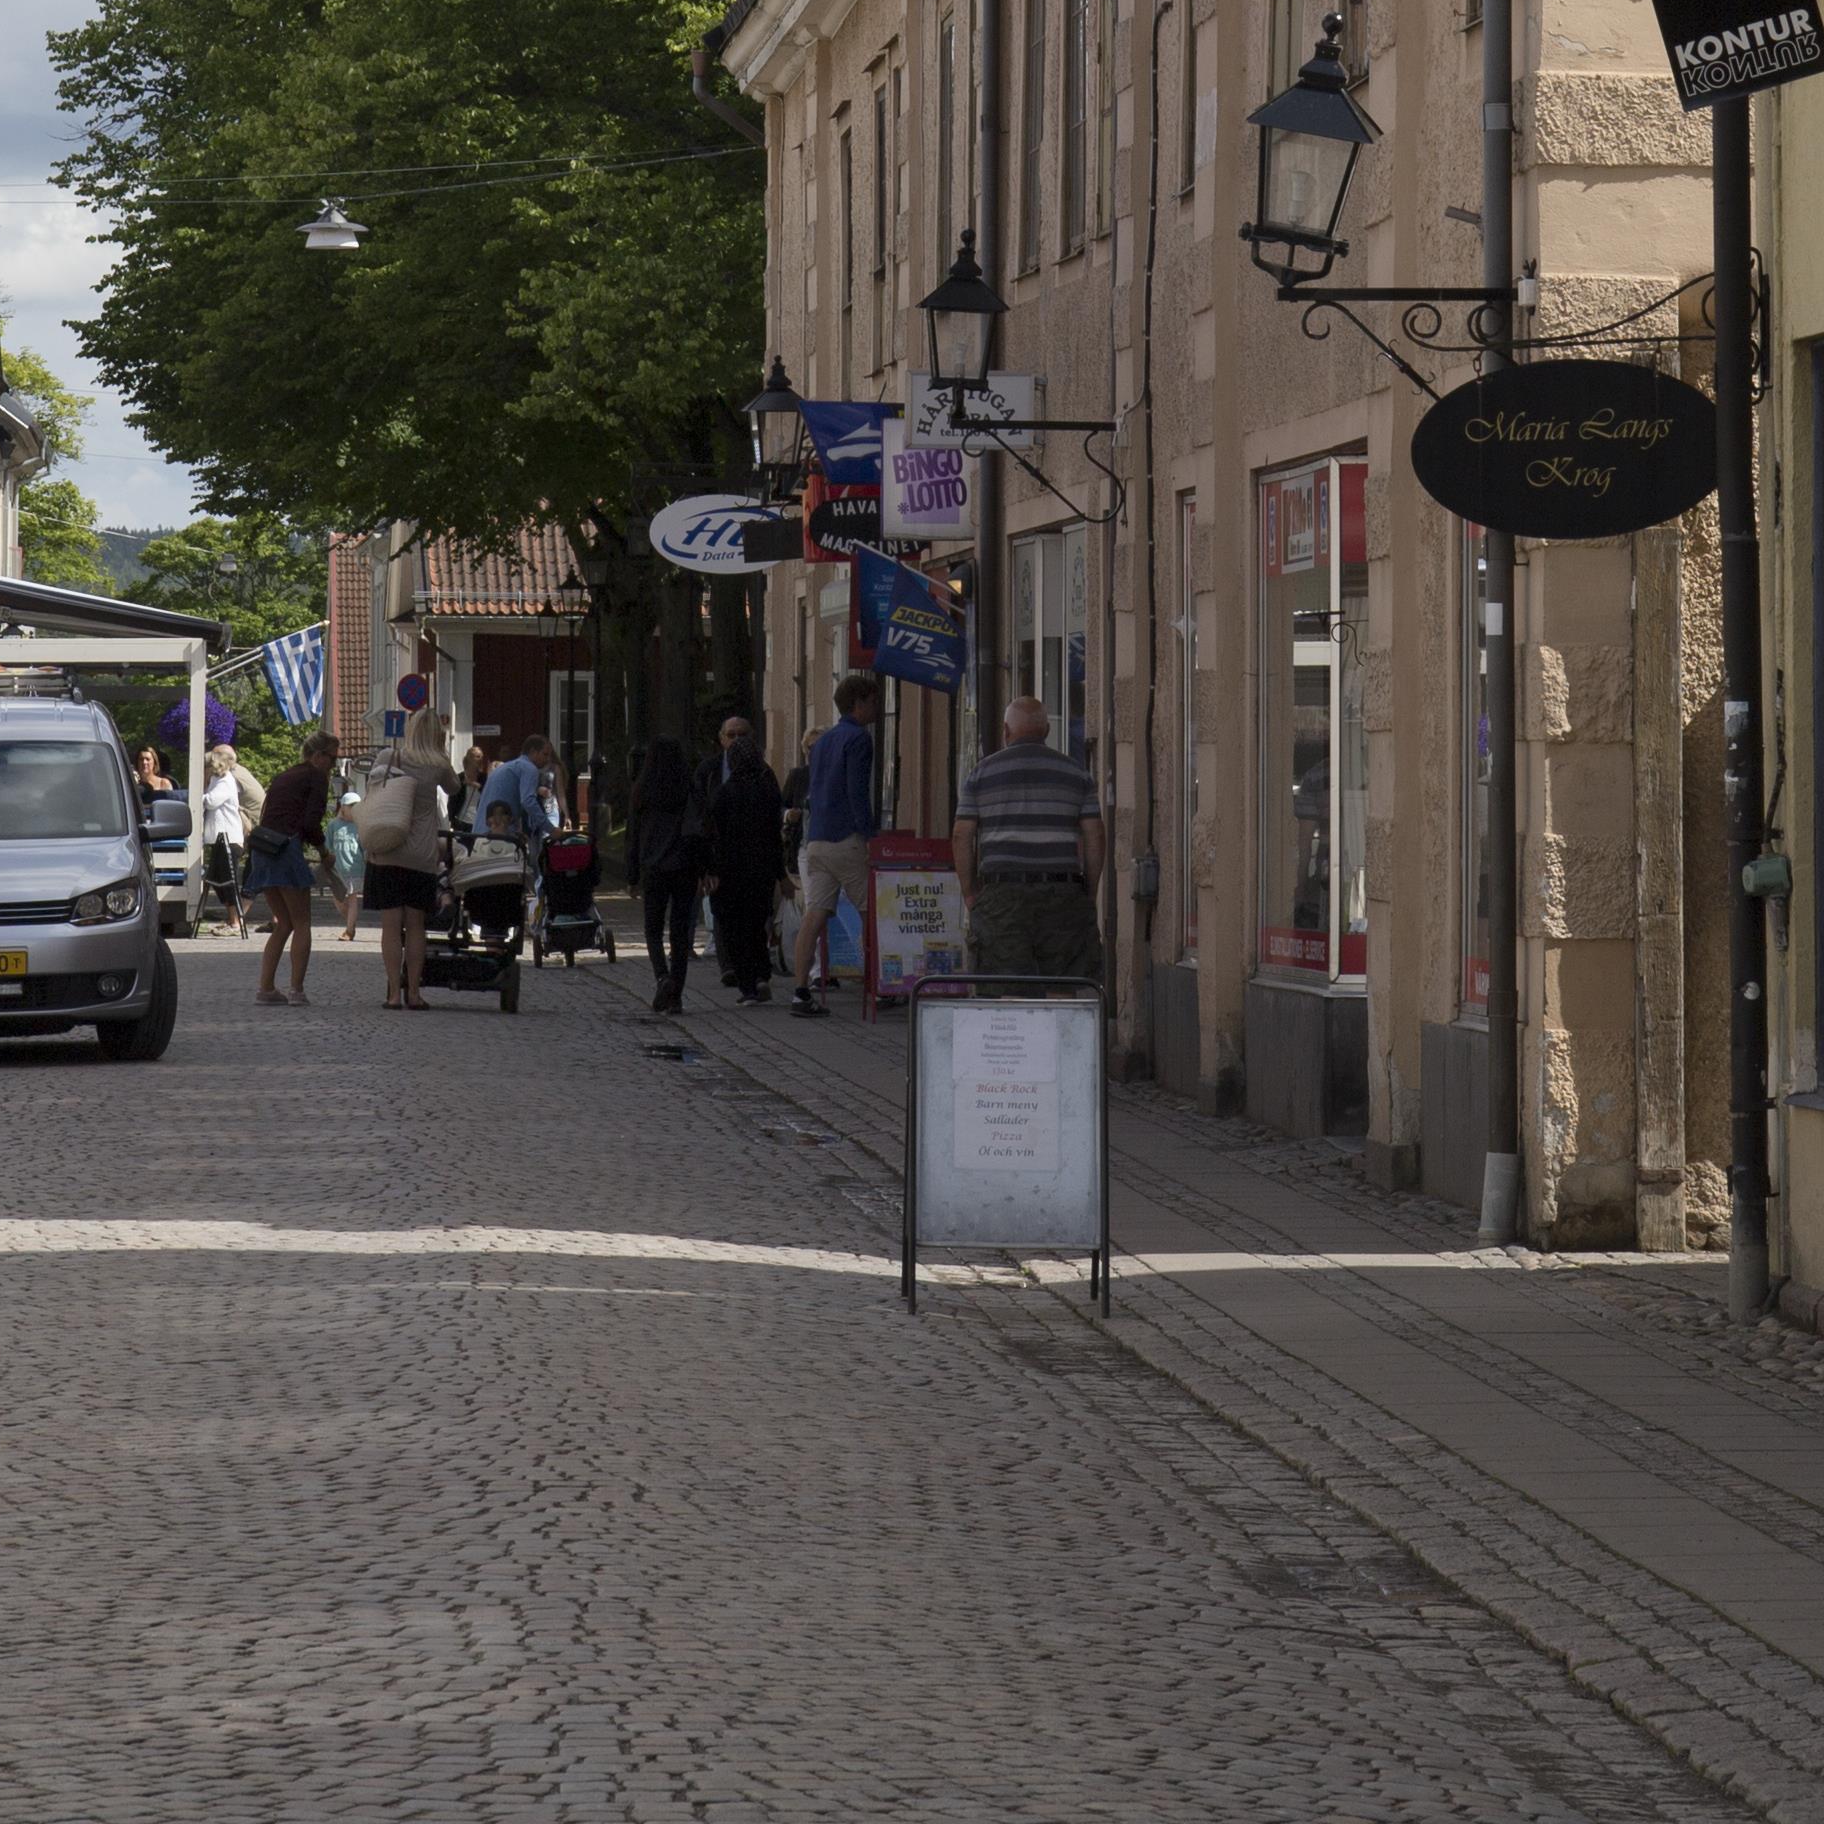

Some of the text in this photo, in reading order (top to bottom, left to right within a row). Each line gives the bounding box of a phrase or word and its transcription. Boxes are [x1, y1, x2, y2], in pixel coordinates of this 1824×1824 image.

[1675, 7, 1815, 69] KONTUR
[1465, 408, 1674, 451] Maria Langs
[1526, 456, 1617, 498] Krog
[906, 476, 967, 514] LOTTO
[832, 500, 877, 517] HAVA
[702, 551, 735, 562] Data
[897, 608, 955, 634] JACKPO
[887, 626, 934, 655] V75
[896, 882, 944, 898] Just nu!
[905, 896, 937, 908] Extra
[900, 909, 943, 924] många
[898, 922, 946, 934] vinster!
[976, 1082, 1039, 1094] Black Rock
[976, 1099, 1039, 1112] Barn meny
[984, 1114, 1030, 1125] Sallader
[991, 1131, 1023, 1141] Pizza
[993, 1146, 1013, 1156] och
[1016, 1148, 1035, 1157] vin
